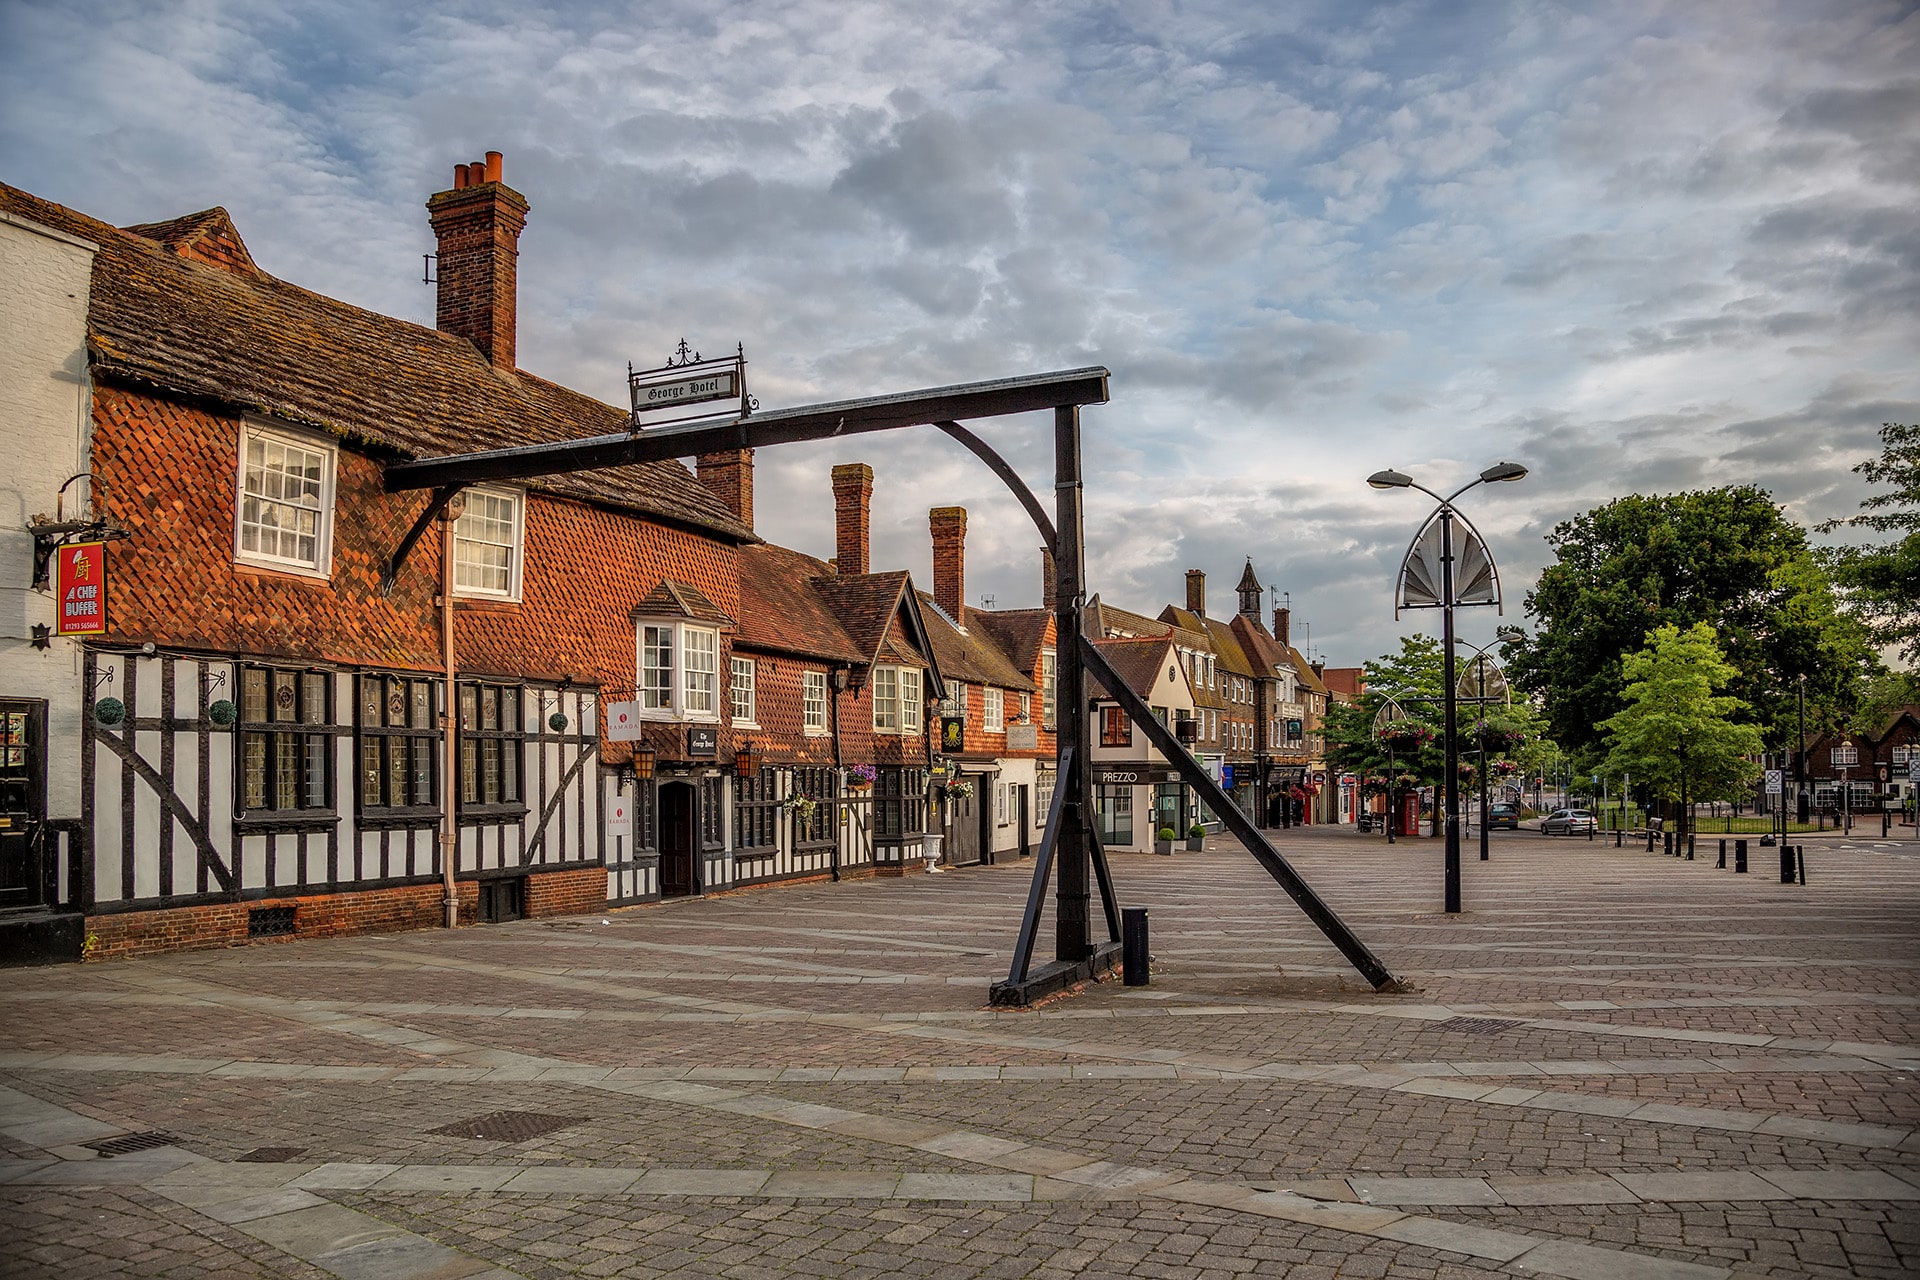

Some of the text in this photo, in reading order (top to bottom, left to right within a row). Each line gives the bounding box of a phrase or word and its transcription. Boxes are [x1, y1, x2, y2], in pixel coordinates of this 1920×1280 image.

[647, 379, 718, 400] George Hotel
[65, 584, 98, 600] A CHEF
[65, 621, 99, 630] 01293 565666
[1102, 772, 1138, 783] PREZZO
